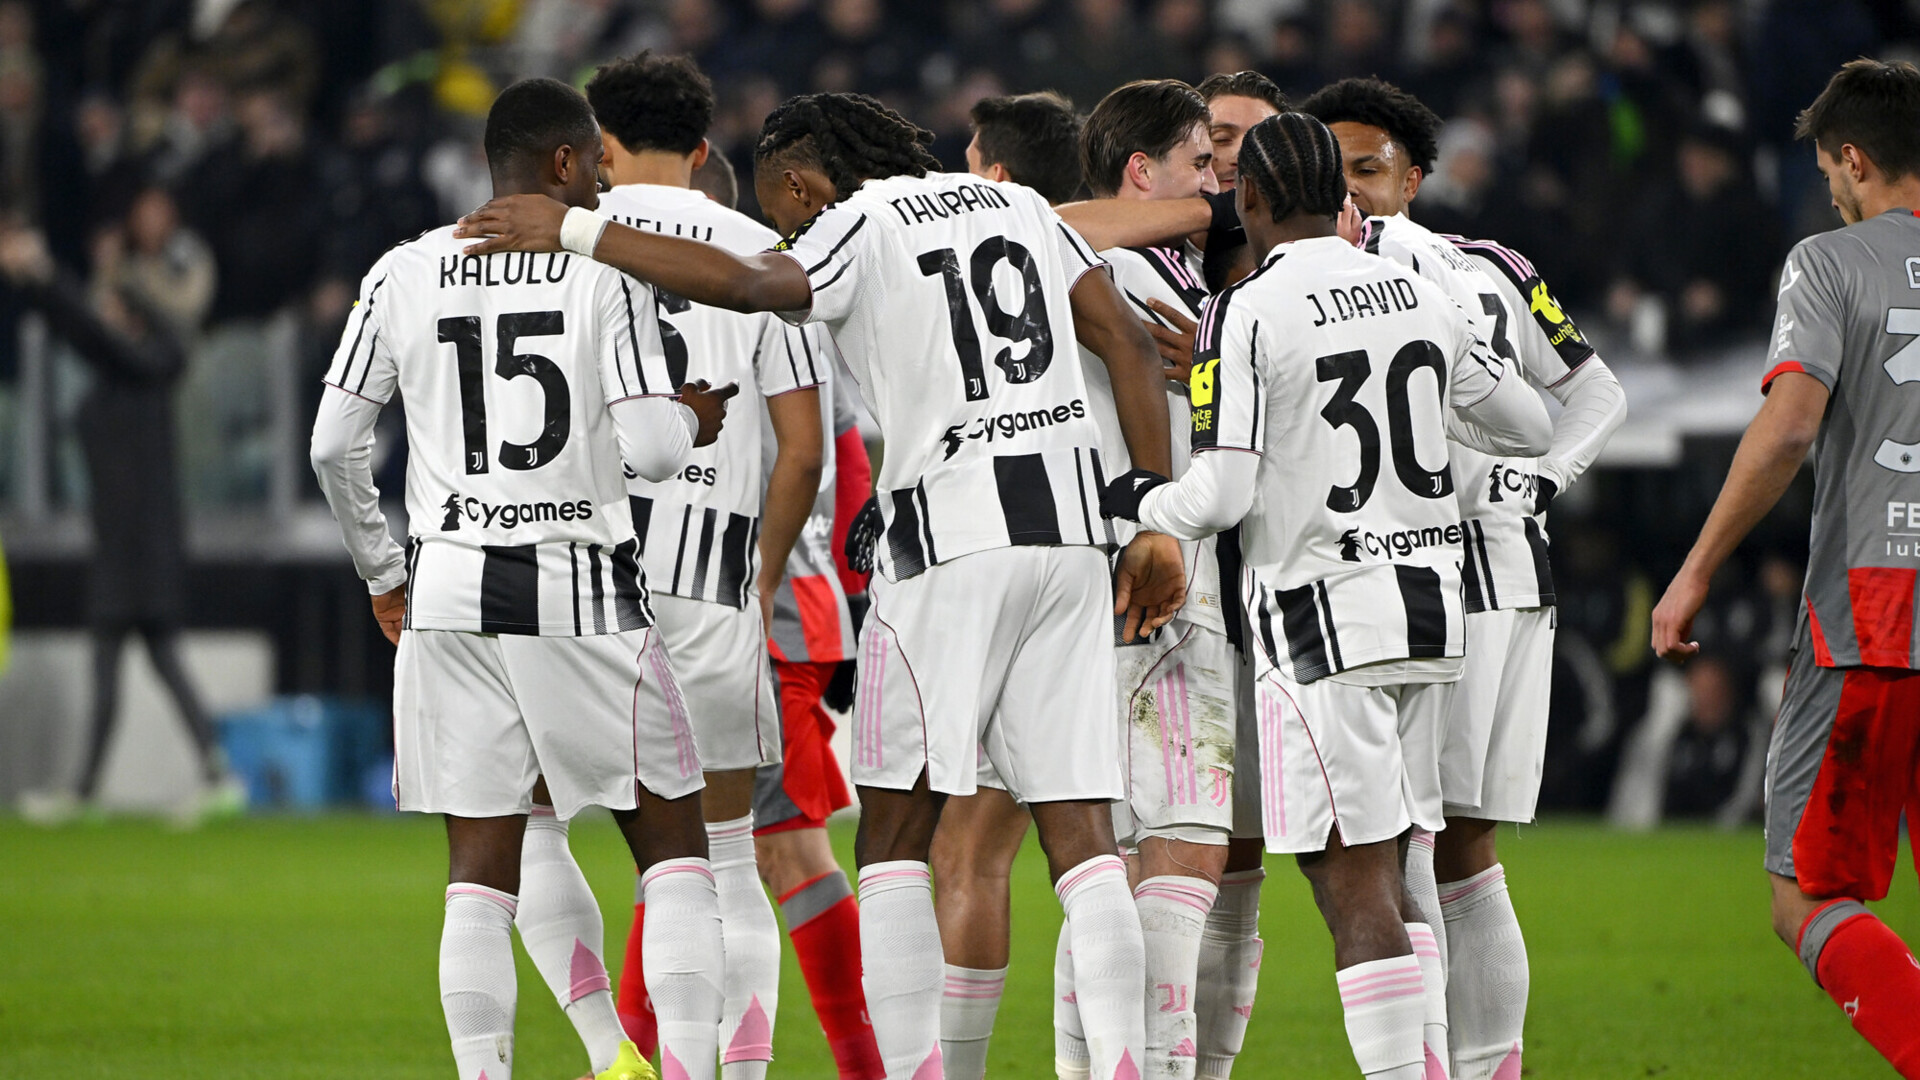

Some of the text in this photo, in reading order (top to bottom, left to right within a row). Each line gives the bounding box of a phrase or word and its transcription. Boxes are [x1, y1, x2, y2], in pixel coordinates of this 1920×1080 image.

[887, 183, 1010, 226] THURAM
[440, 253, 570, 288] KALULU
[916, 235, 1054, 402] 19
[1306, 277, 1419, 327] J.DAVID
[437, 310, 571, 475] 15
[1315, 339, 1456, 514] 30
[465, 497, 593, 529] Cygames
